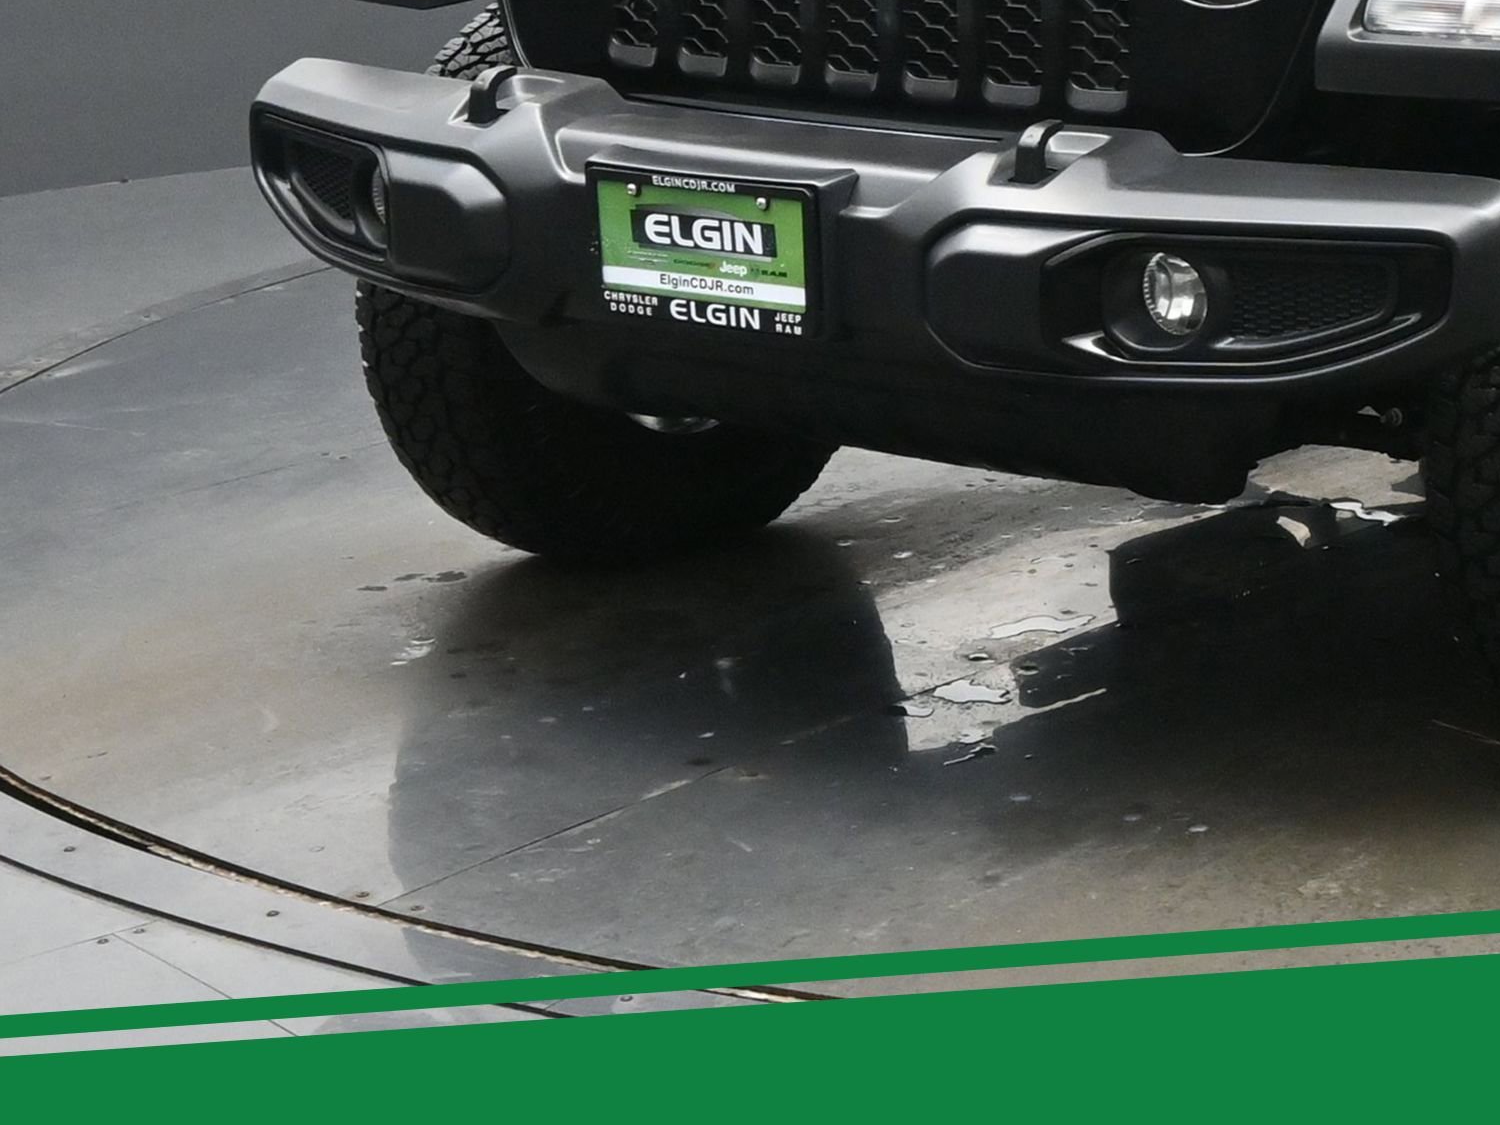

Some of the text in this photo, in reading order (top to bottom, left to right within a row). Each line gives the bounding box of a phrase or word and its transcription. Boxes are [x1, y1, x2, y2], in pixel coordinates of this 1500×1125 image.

[652, 175, 736, 193] ELGINCDJR.COM
[644, 213, 764, 255] ELGIN
[719, 261, 748, 277] Jeep
[659, 273, 755, 295] ElginCDJR.com
[603, 291, 659, 306] CHRYSLER
[610, 302, 653, 316] DODGE
[669, 299, 761, 330] ELGIN
[774, 312, 802, 323] JEEP
[775, 324, 803, 335] RAM
